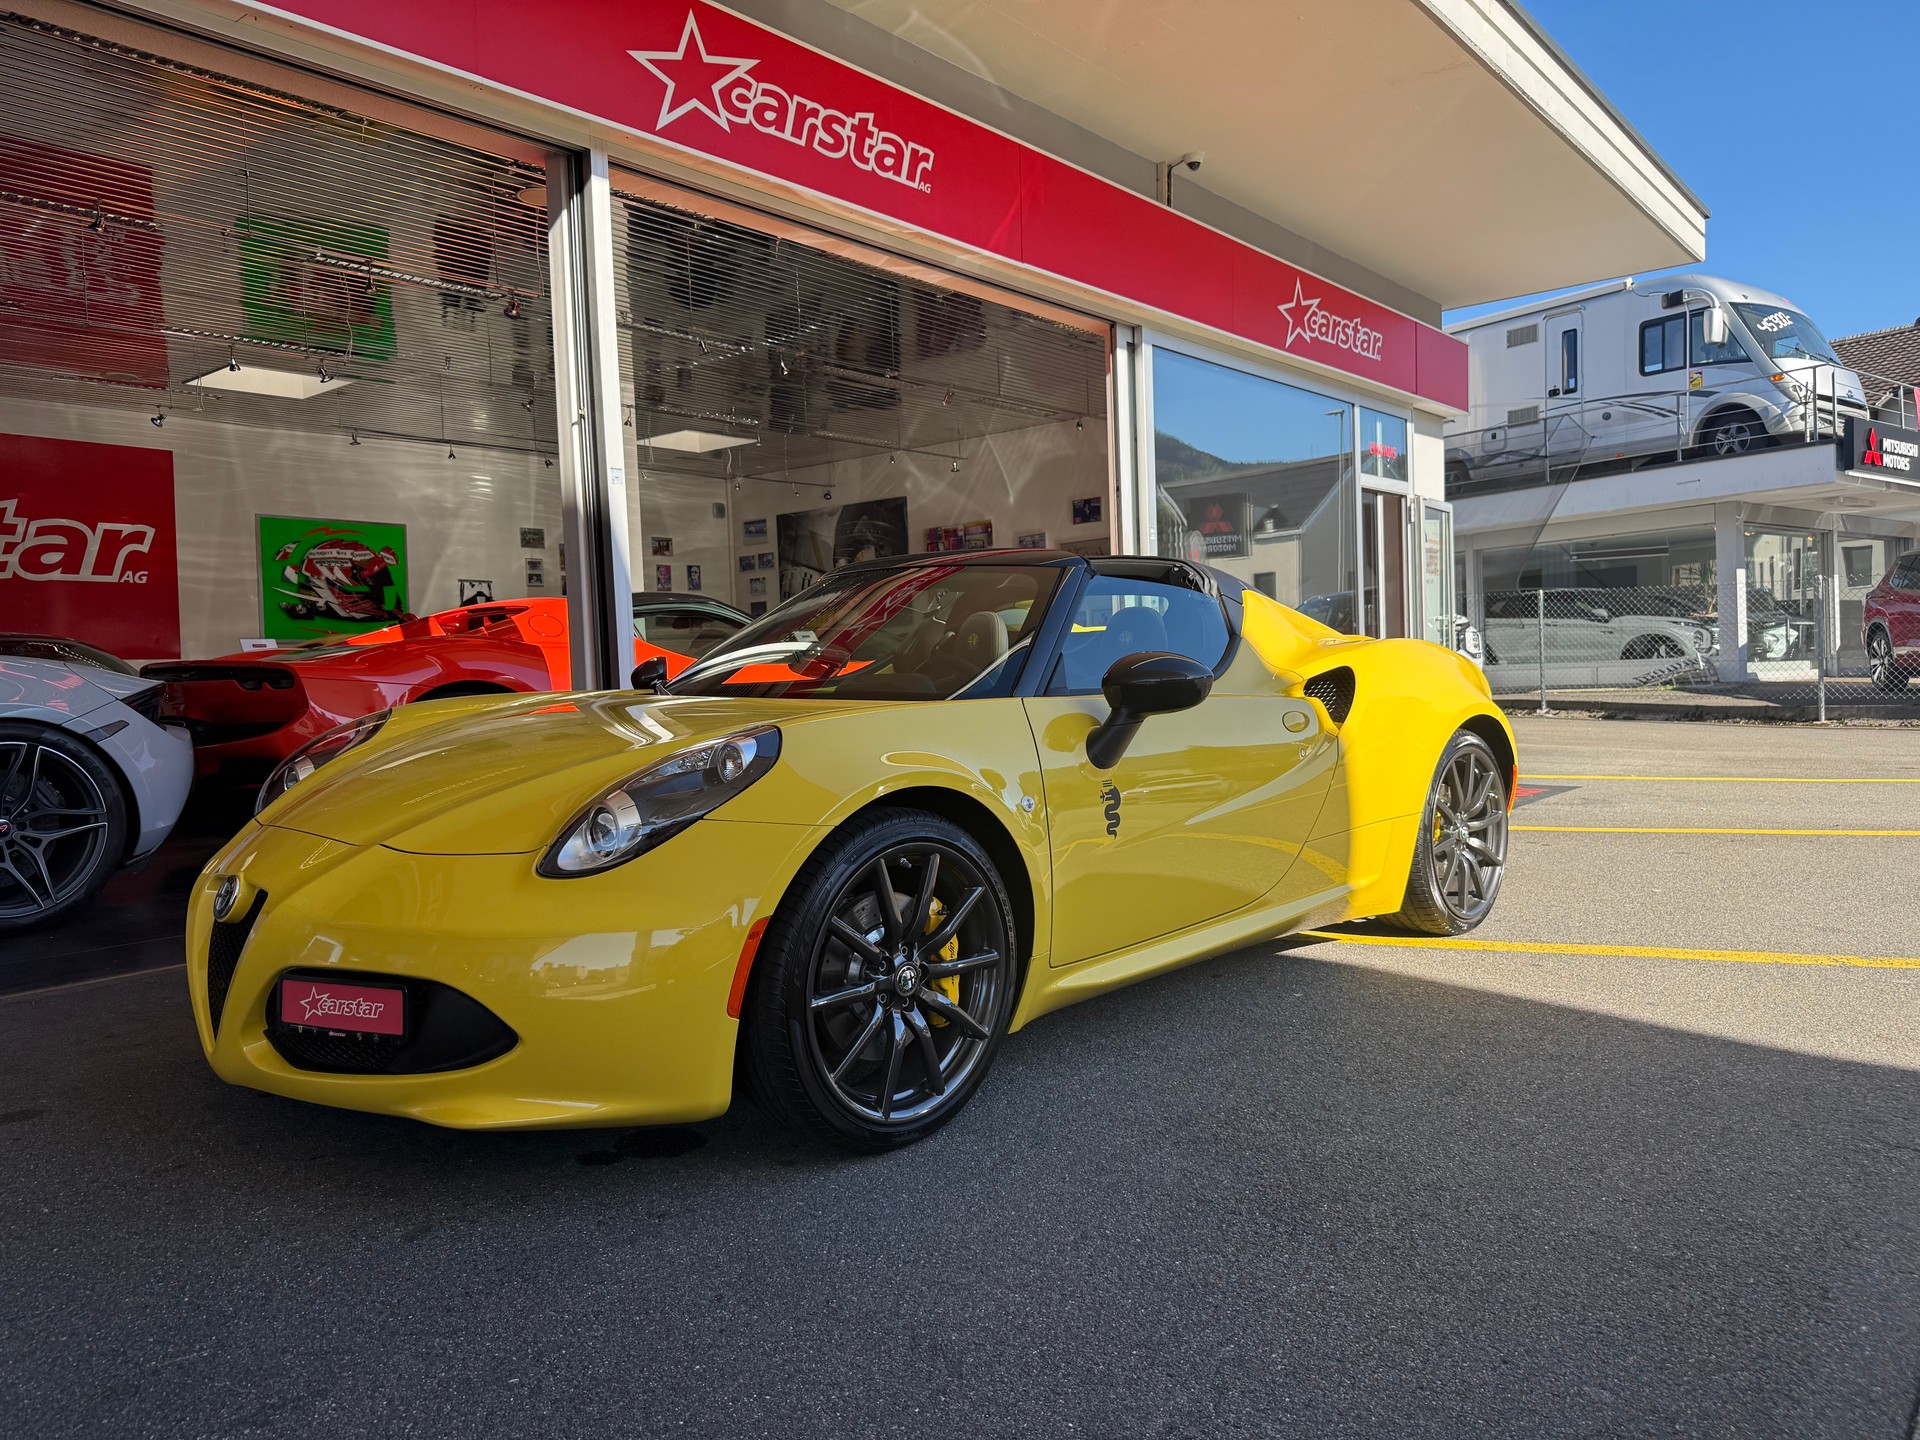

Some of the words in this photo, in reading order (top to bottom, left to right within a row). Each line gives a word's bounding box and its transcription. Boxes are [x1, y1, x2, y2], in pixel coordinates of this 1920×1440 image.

[712, 72, 934, 188] carstar
[918, 181, 931, 194] AG
[1305, 308, 1382, 359] carstar
[1883, 438, 1918, 457] MITSUBISHI
[1883, 454, 1910, 471] MOTORS
[120, 571, 148, 584] AG
[319, 998, 383, 1018] carstar
